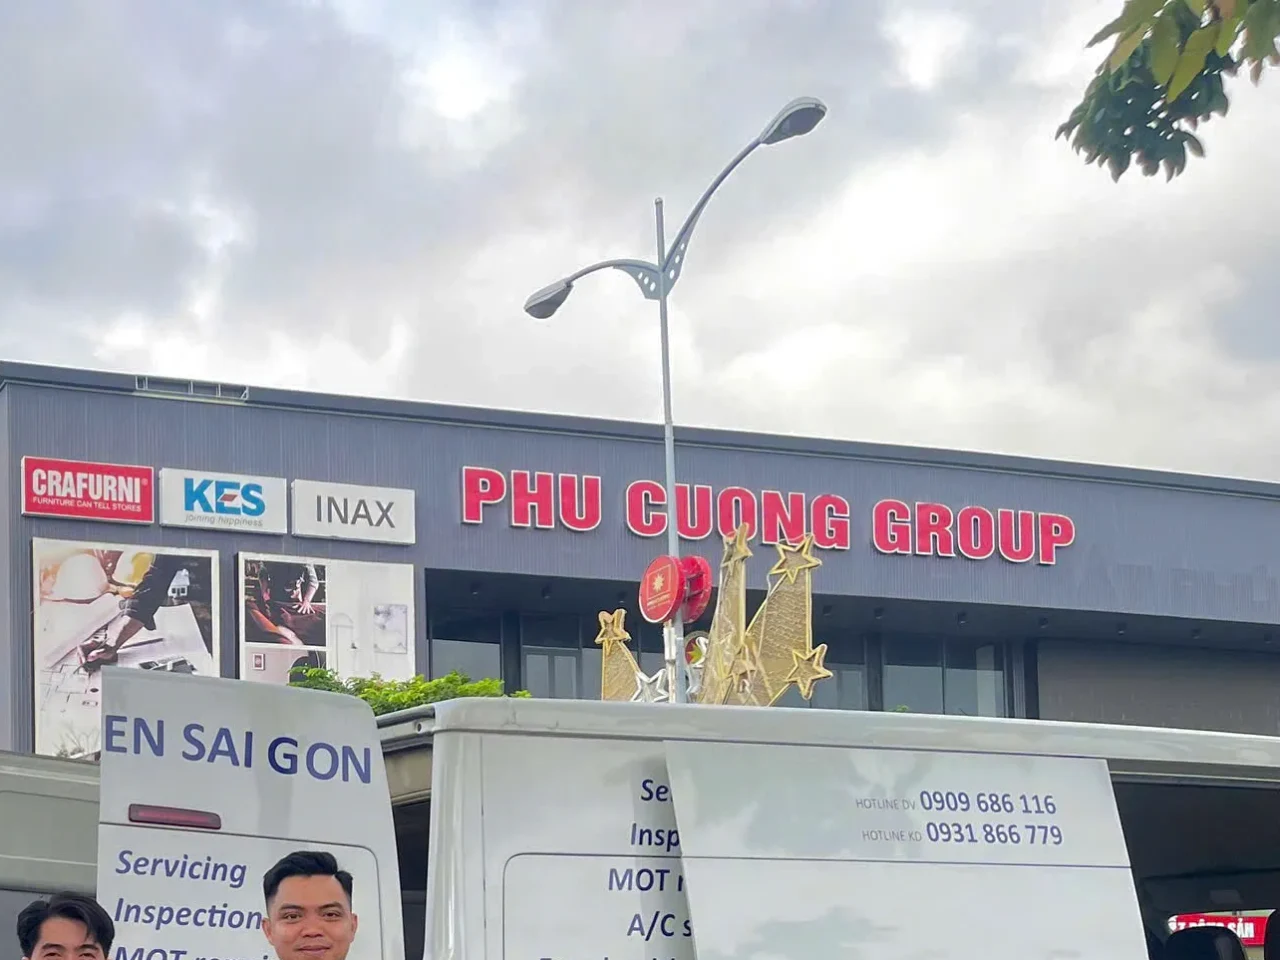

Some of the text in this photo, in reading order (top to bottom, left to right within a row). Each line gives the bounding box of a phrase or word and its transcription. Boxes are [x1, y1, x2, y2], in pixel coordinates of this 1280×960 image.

[32, 496, 142, 513] FURNITURE CAN TELL STORES
[183, 477, 266, 517] KES
[316, 494, 396, 529] INAX
[185, 513, 264, 528] joining happiness
[461, 465, 1077, 566] PHU CUONG GROUP
[104, 714, 165, 758] EN
[855, 799, 900, 811] HOTLINE
[919, 790, 971, 812] 0909
[976, 792, 1014, 813] 686
[1019, 794, 1057, 815] 116
[862, 829, 906, 842] HOTLINE
[926, 822, 978, 843] 0931
[982, 823, 1021, 844] 866
[1024, 825, 1063, 845] 779
[115, 850, 247, 889] Servicing
[608, 868, 670, 891] MOT
[114, 898, 263, 931] Inspection
[626, 911, 676, 942] A/C
